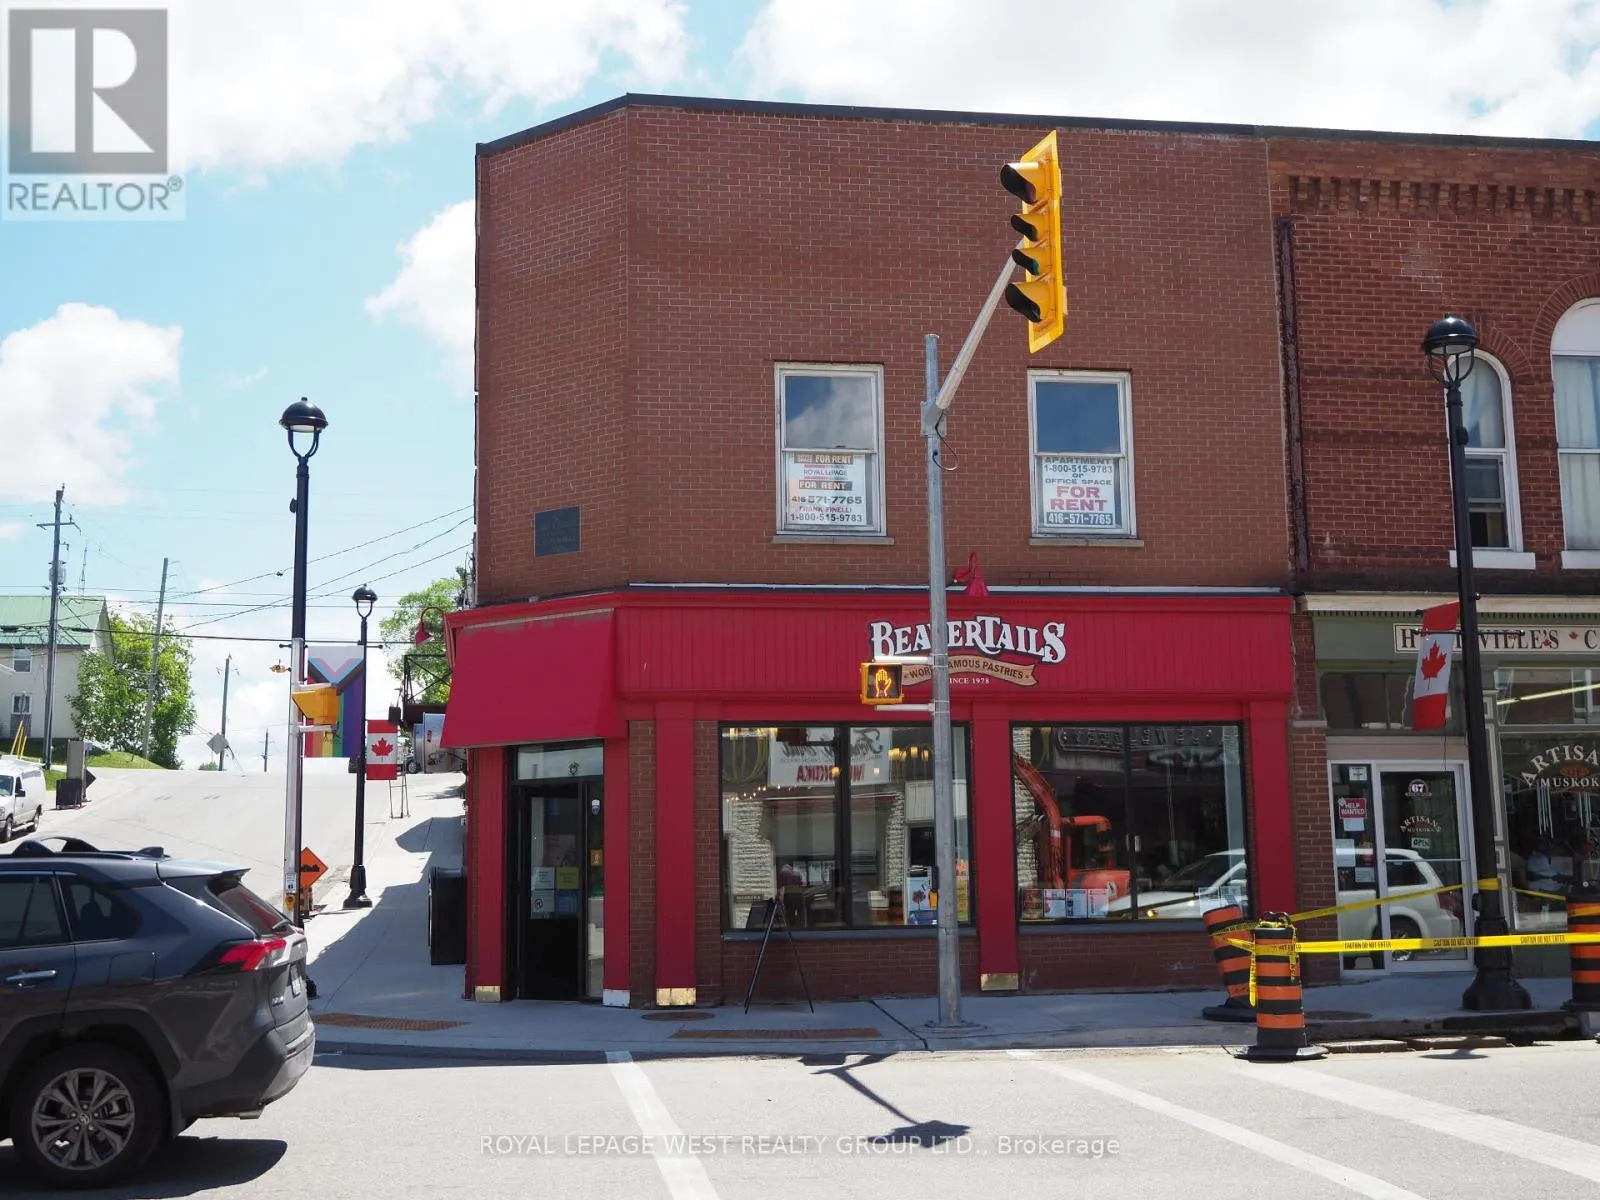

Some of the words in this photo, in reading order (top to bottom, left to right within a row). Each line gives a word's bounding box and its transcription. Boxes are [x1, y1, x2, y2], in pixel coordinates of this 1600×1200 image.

[815, 455, 830, 464] FOR
[832, 455, 852, 464] RENT
[1044, 465, 1113, 473] 1-800-515-9783
[799, 481, 817, 489] FOR
[821, 482, 847, 490] RENT
[1056, 486, 1100, 498] FOR
[1050, 499, 1108, 511] RENT
[791, 513, 864, 522] 1-800-515-9783
[1048, 513, 1111, 524] 416-571-7765
[871, 615, 1066, 664] BEAERTAILS
[947, 659, 980, 669] AMOUS
[982, 661, 1024, 679] PASTRIES
[1411, 783, 1424, 793] 67
